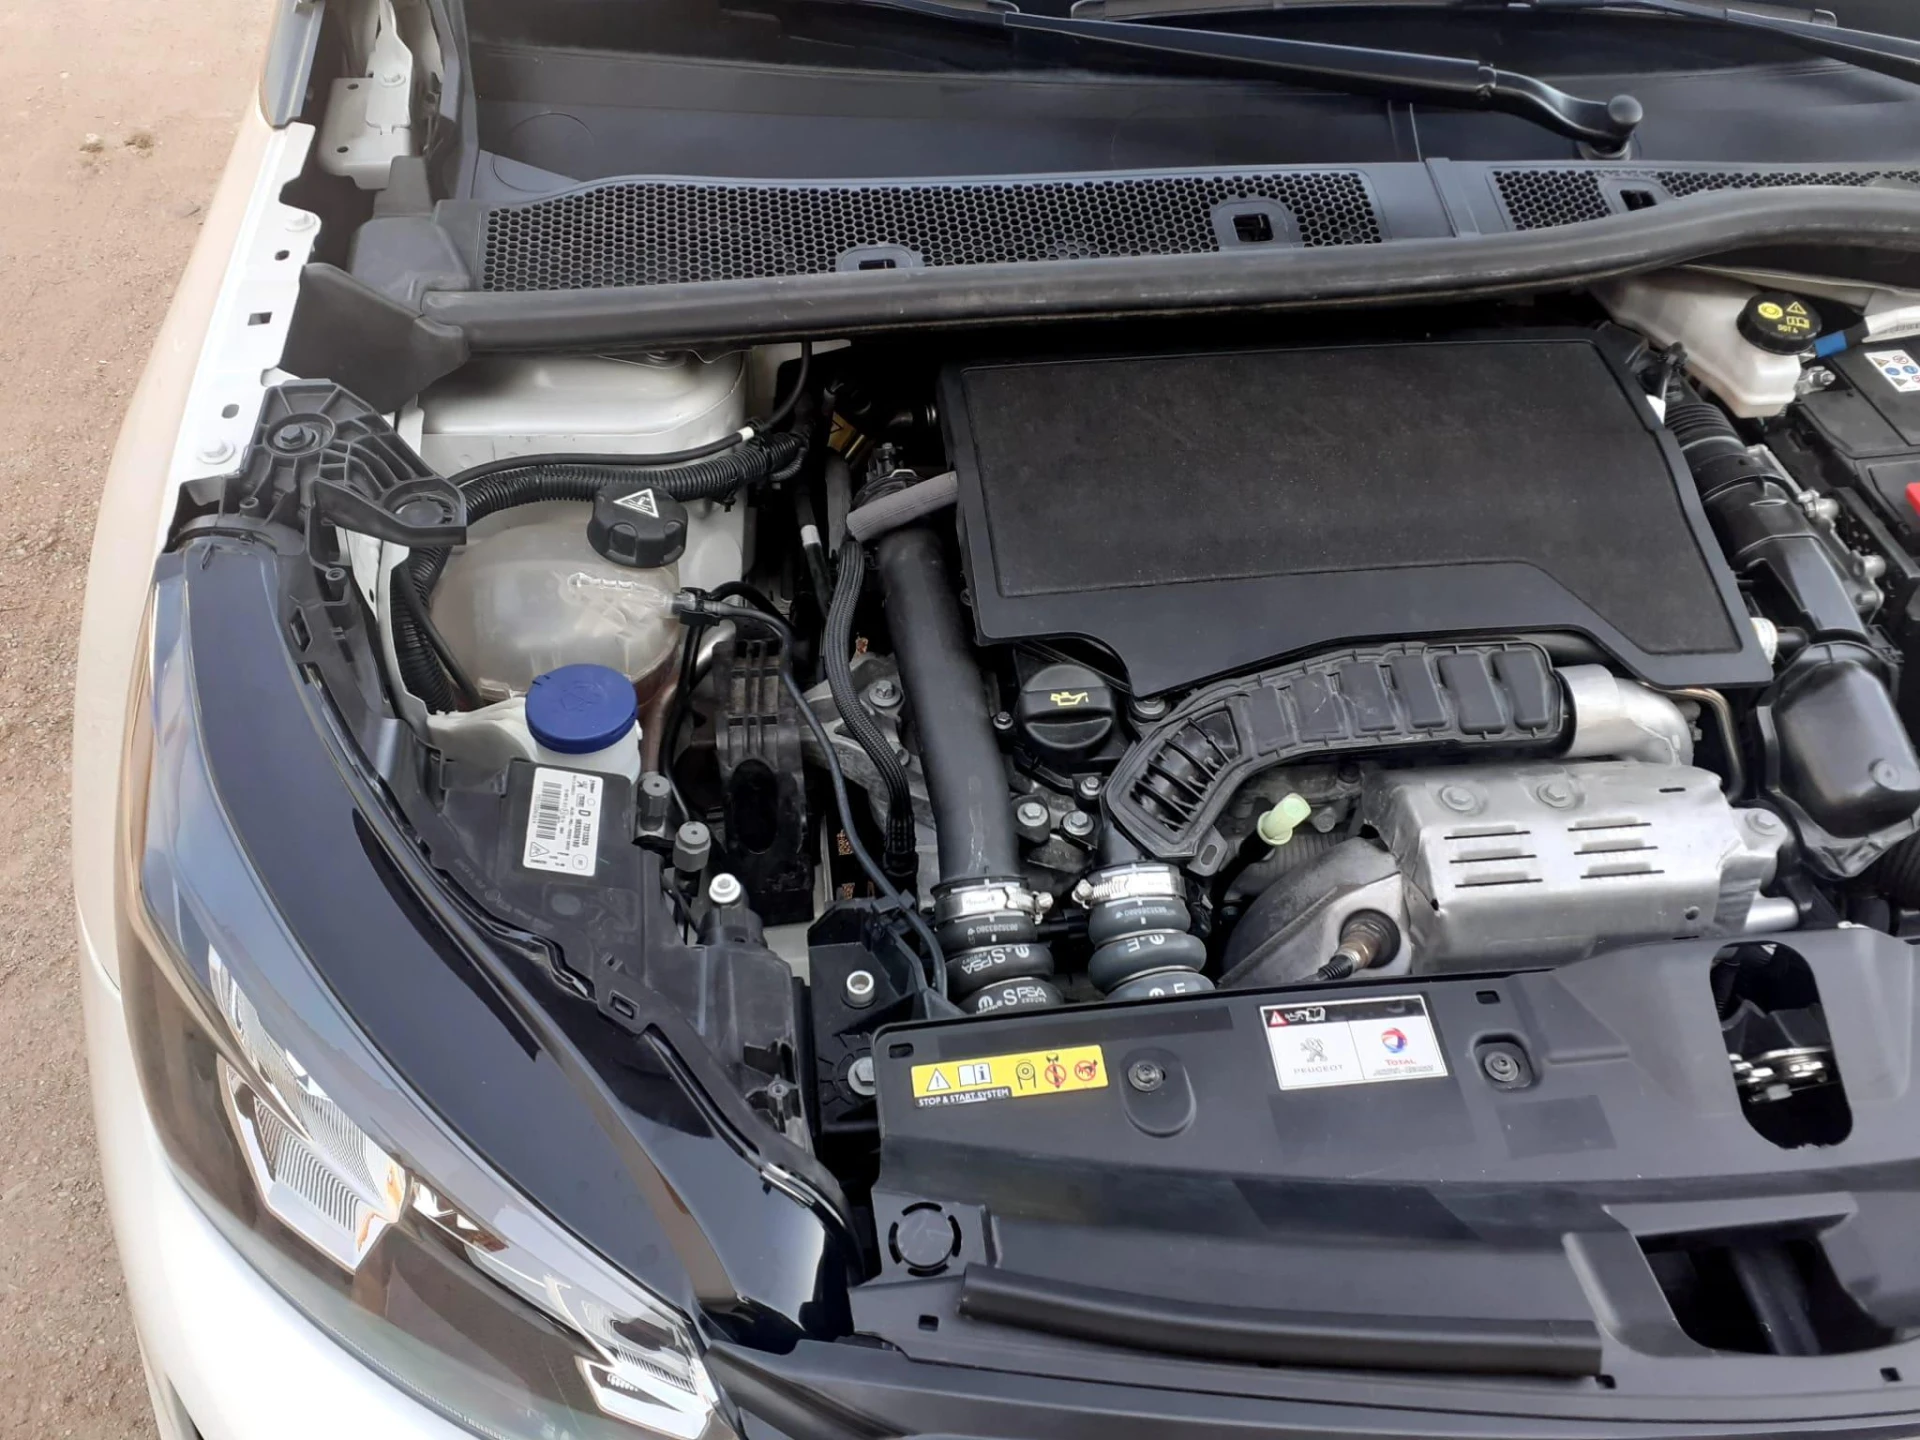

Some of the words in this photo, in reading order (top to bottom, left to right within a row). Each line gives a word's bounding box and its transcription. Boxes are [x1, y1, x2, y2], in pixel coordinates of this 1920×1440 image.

[1777, 324, 1792, 333] DOT
[1018, 985, 1047, 998] PSA
[1385, 1058, 1417, 1066] TOTAL
[1294, 1064, 1344, 1075] PEUGEOT
[918, 1097, 941, 1107] STOP
[942, 1096, 949, 1104] &
[949, 1092, 976, 1104] START
[976, 1088, 1009, 1100] SYSTEM
